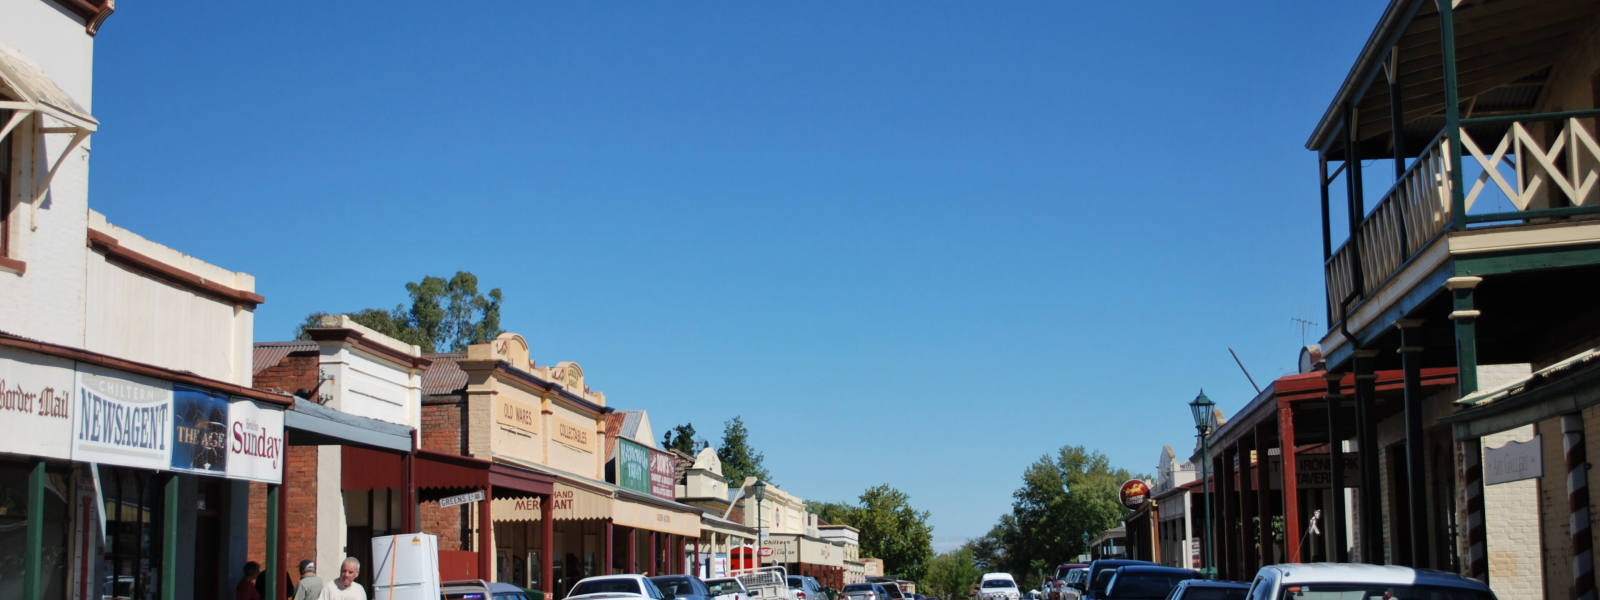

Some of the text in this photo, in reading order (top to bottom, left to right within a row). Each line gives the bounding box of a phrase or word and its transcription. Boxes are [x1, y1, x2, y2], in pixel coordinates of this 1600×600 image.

[38, 386, 70, 419] Mail
[98, 380, 154, 402] CHILTERN
[79, 386, 169, 450] NEWSAGENT
[503, 402, 533, 426] OLD WARES
[177, 425, 225, 449] THE AGE
[232, 420, 282, 470] Sunday
[441, 494, 467, 507] GREENS
[514, 498, 574, 511] MERANT
